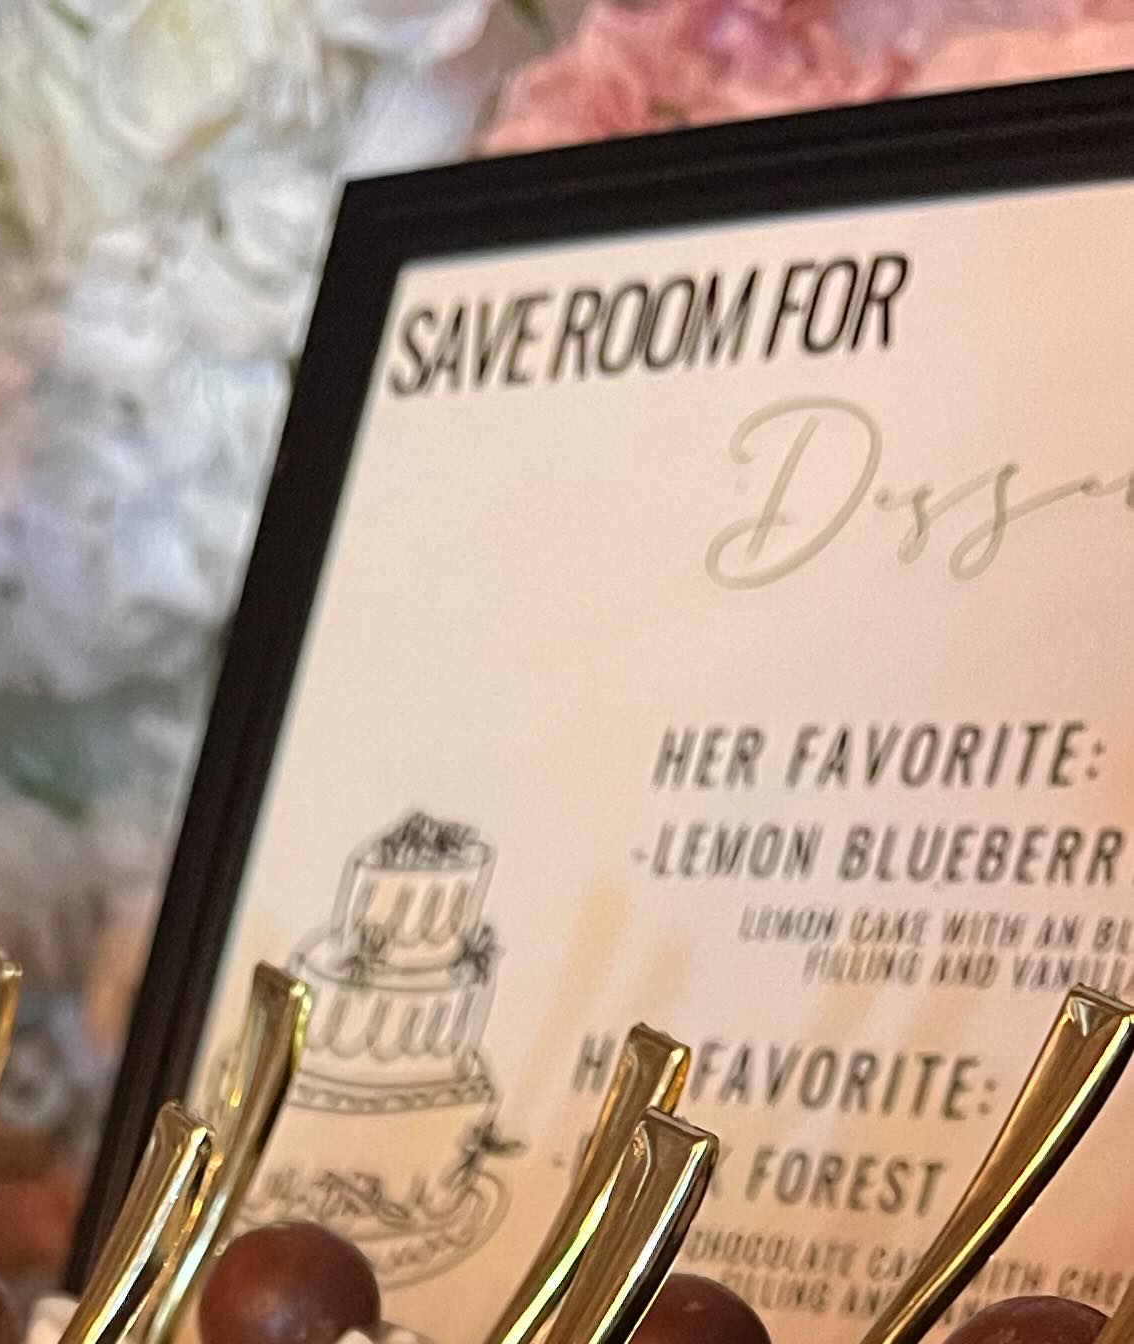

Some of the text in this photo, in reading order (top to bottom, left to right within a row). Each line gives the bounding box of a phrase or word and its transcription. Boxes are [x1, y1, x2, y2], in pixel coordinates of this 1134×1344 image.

[389, 252, 910, 397] SAVE ROOM FOR
[704, 394, 1134, 591] Desse
[651, 720, 1107, 793] HER FAVORITE:
[839, 825, 1134, 884] BLUEBERR
[738, 904, 840, 942] LEMON
[929, 949, 1000, 990] AND
[687, 1038, 997, 1120] FAVORITE:
[746, 1144, 946, 1219] FOREST
